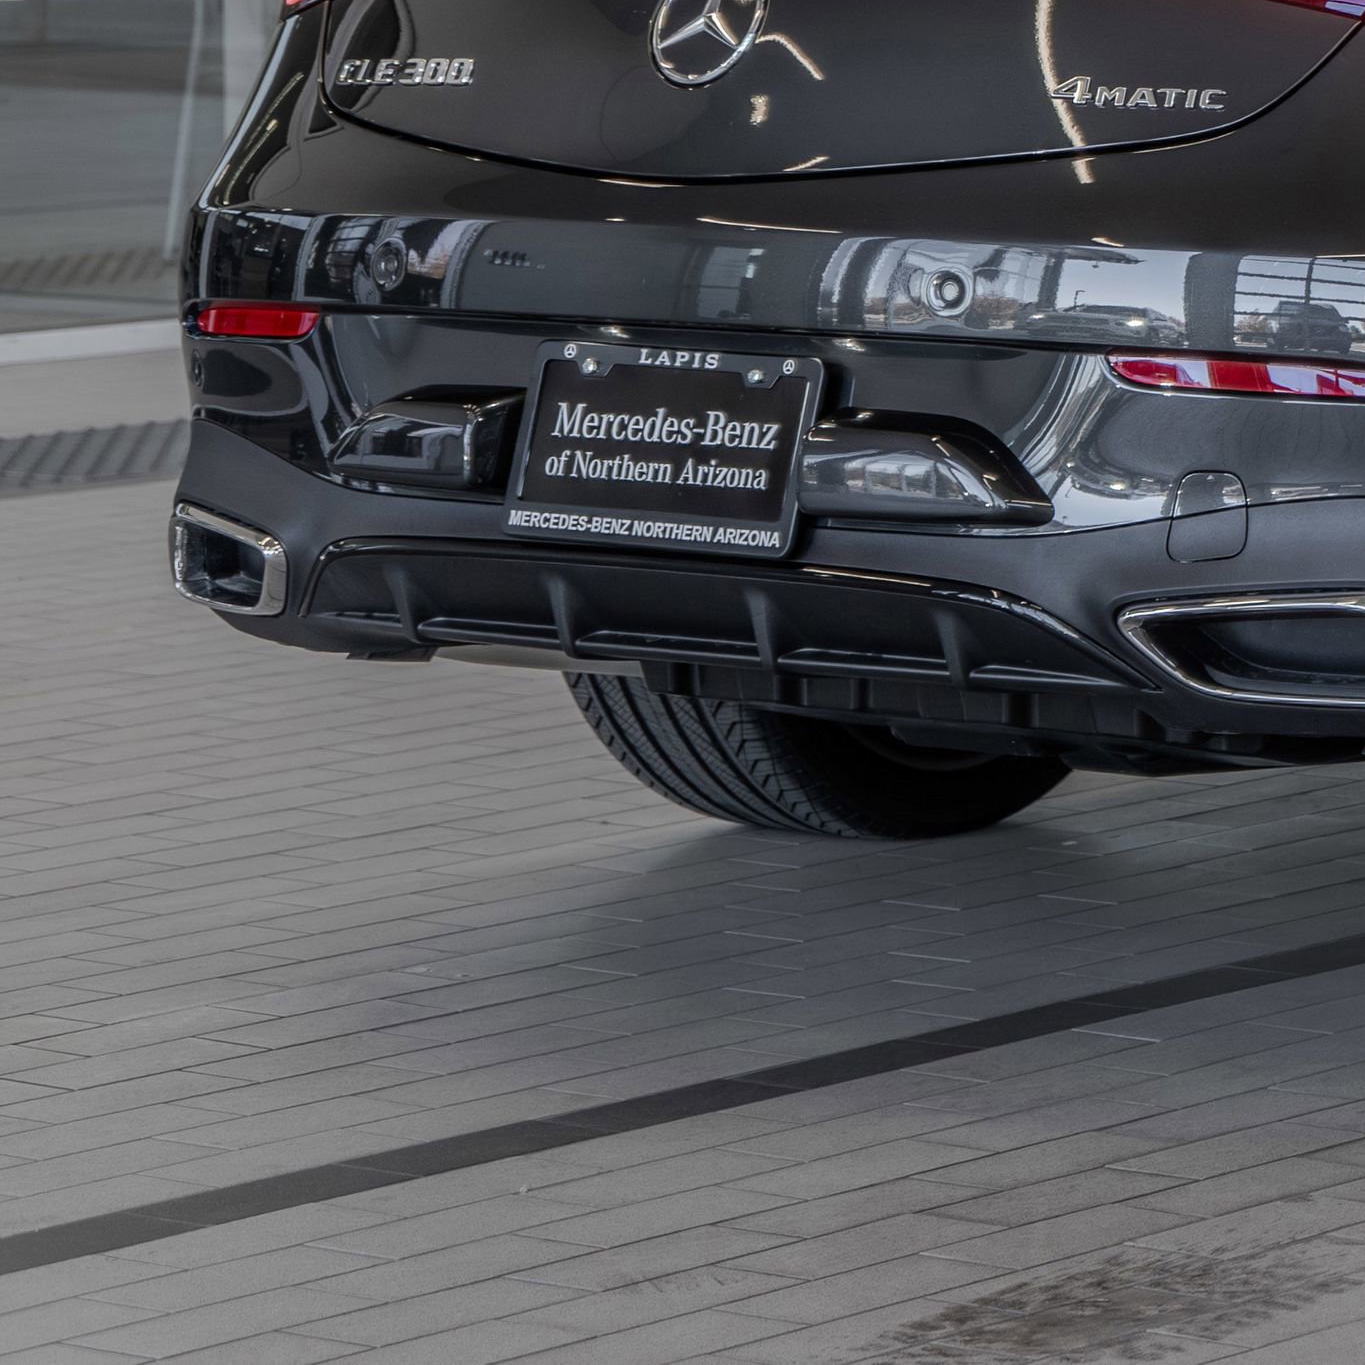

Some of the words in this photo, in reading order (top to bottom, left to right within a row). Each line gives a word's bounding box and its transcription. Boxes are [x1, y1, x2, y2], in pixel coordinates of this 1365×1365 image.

[1051, 75, 1228, 111] 4MATIC
[639, 348, 721, 370] LAPIS
[551, 401, 783, 451] Mercedes-Benz
[545, 449, 571, 477] of
[570, 451, 672, 484] Northern
[677, 457, 768, 490] Arizona
[508, 509, 631, 537] MERCEDES-BENZ
[632, 519, 714, 543] NORTHERN
[712, 527, 780, 548] ARIZONA
